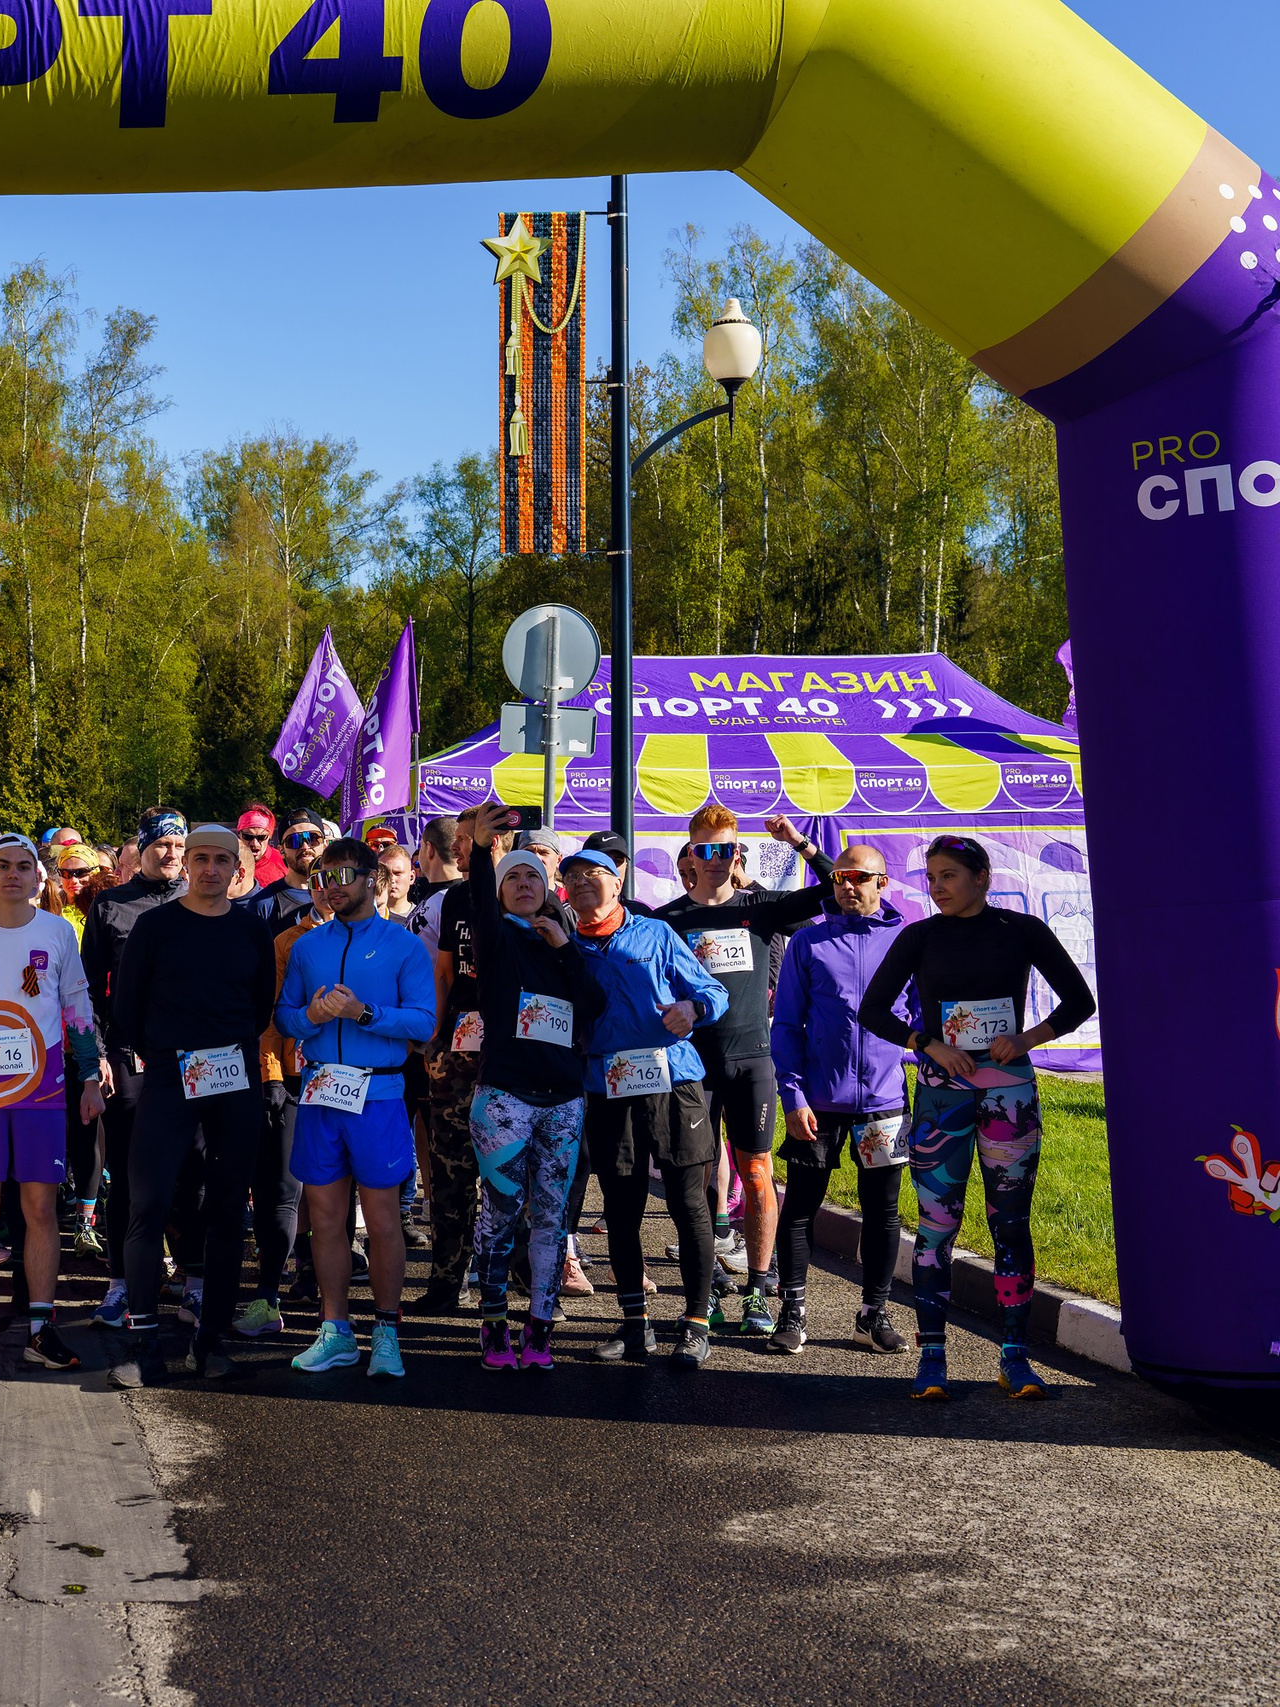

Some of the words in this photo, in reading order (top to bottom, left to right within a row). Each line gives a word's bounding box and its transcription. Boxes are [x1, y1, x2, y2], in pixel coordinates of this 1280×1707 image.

[268, 0, 552, 123] 40
[1132, 431, 1220, 470] PRO
[1137, 460, 1280, 520] СПО
[689, 670, 937, 694] МАГАЗИН
[777, 697, 840, 717] 40
[708, 717, 754, 726] БУДЬ
[758, 717, 770, 725] В
[773, 716, 847, 726] СПОРТЕ!
[365, 762, 386, 806] 40
[426, 776, 469, 787] СПОРТ
[471, 778, 487, 787] 40
[716, 780, 758, 789] СПОРТ
[760, 780, 776, 789] 40
[860, 778, 903, 788] СПОРТ
[905, 778, 922, 787] 40
[1006, 774, 1048, 784] СПОРТ
[1051, 774, 1067, 783] 40
[723, 946, 745, 959] 121
[710, 960, 747, 969] Вячеслав
[549, 1017, 569, 1033] 190
[981, 1019, 1008, 1034] 173
[5, 1049, 22, 1061] 16
[215, 1064, 239, 1079] 110
[636, 1067, 662, 1080] 167
[210, 1081, 234, 1089] Игорь
[333, 1083, 360, 1099] 104
[626, 1081, 660, 1091] Алексей
[319, 1094, 353, 1106] Ярослав
